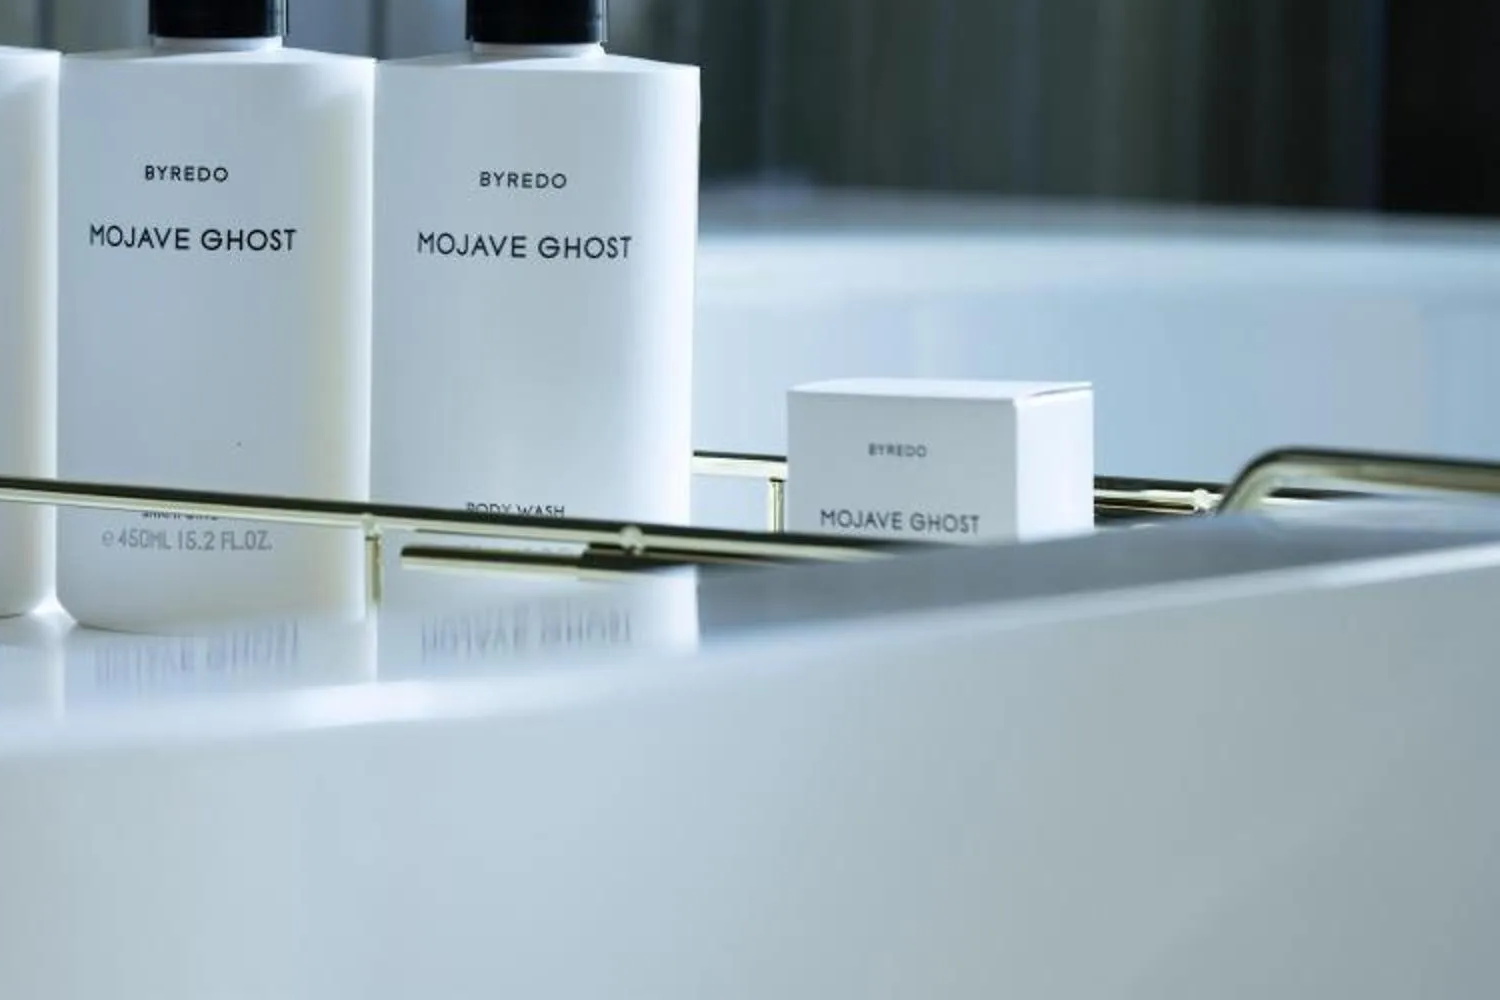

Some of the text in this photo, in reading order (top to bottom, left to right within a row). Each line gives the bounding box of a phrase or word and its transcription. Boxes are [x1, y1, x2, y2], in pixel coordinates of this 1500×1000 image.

[143, 164, 229, 184] BYREDO
[478, 170, 568, 190] BYREDO
[89, 223, 298, 252] MOJAVE GHOST
[416, 231, 633, 260] MOJAVE GHOST
[868, 442, 928, 459] BYREDO
[819, 508, 980, 535] MOJAVE GHOST
[177, 530, 215, 550] 15.2
